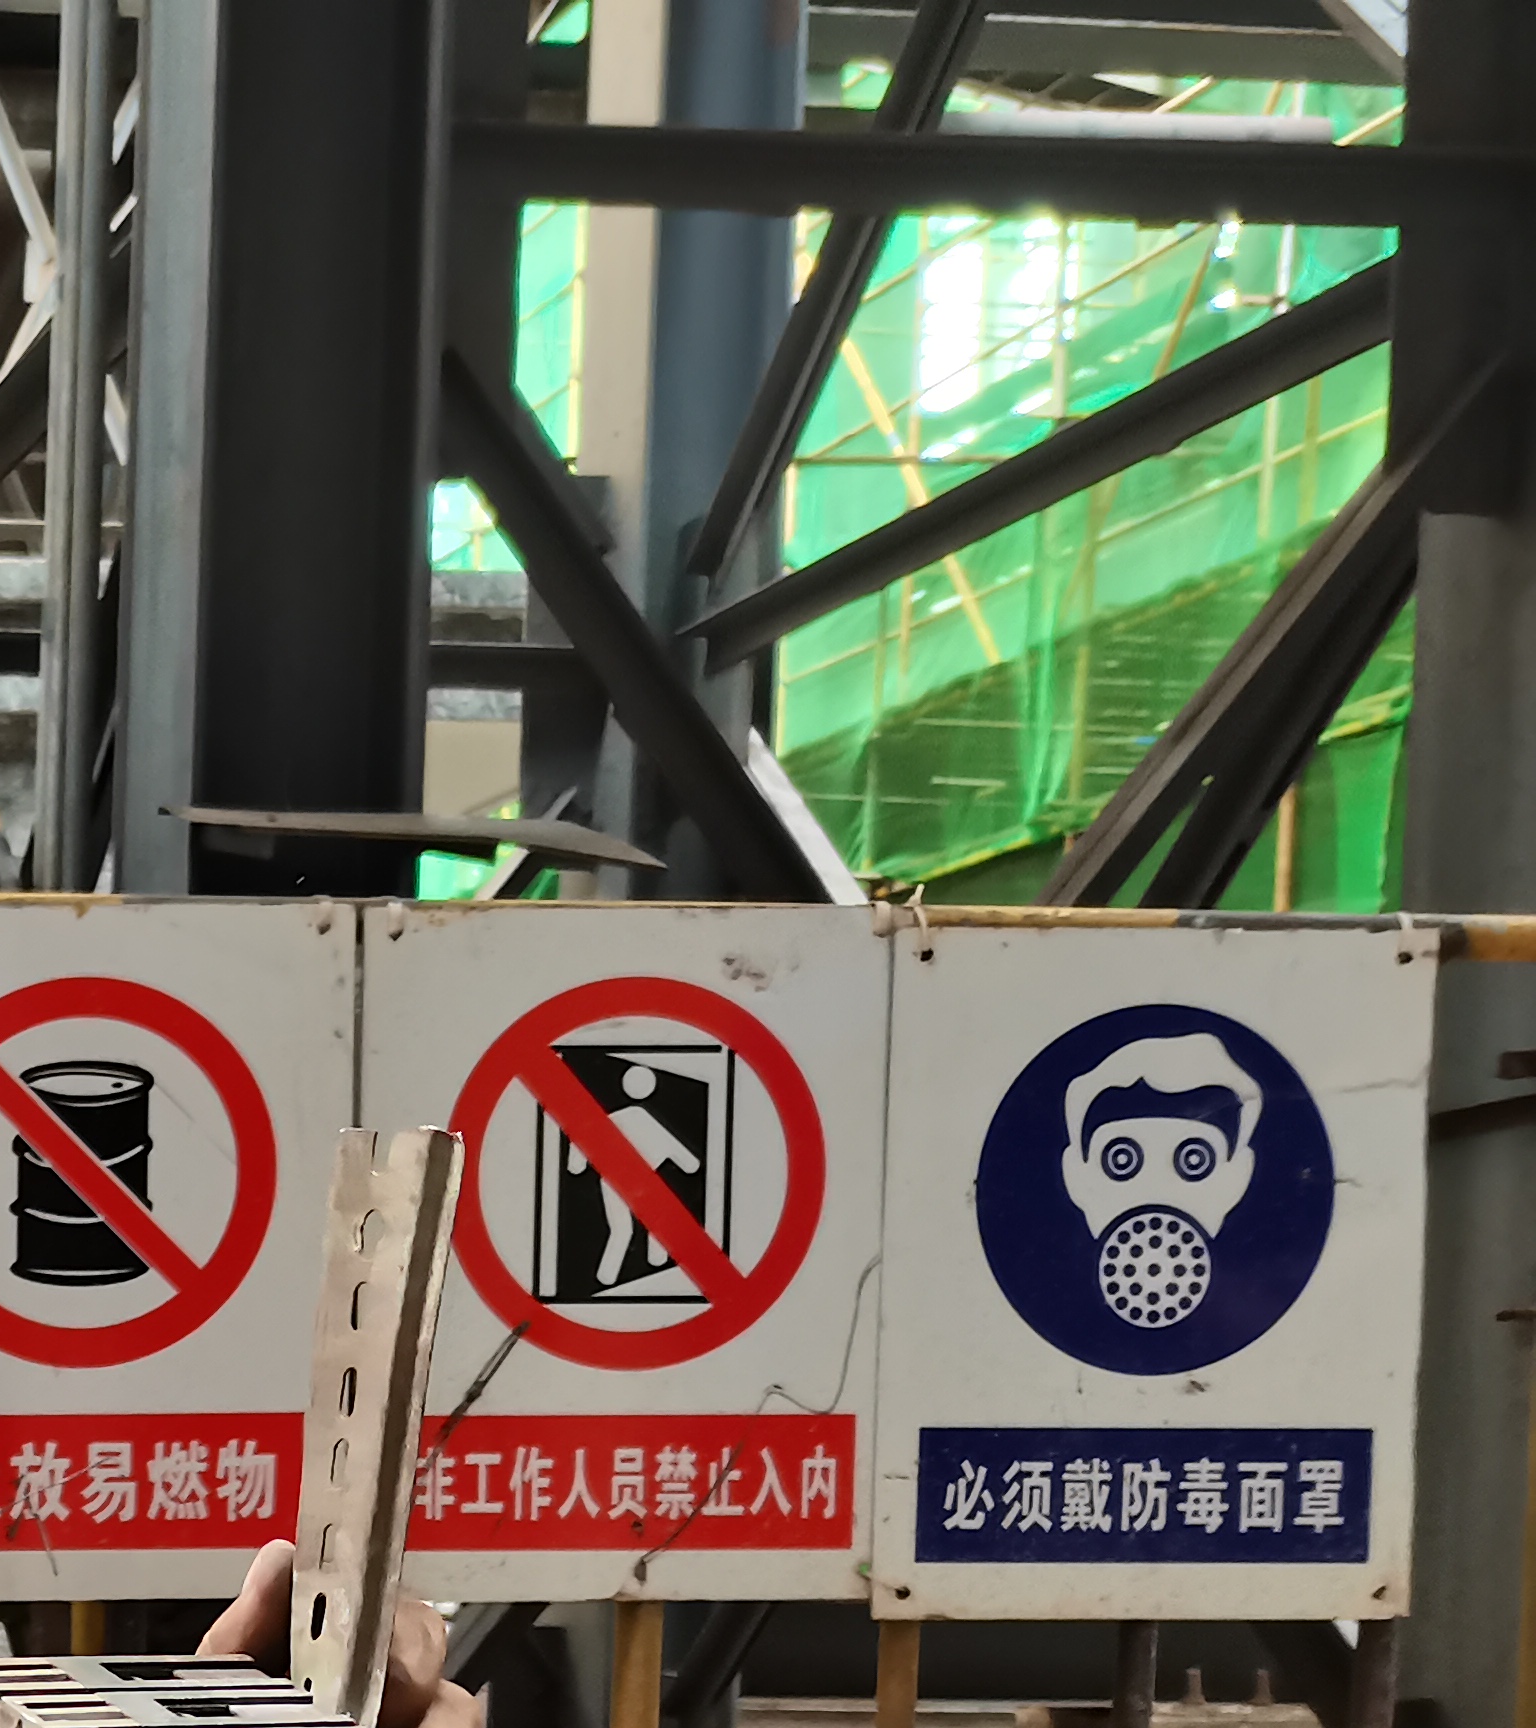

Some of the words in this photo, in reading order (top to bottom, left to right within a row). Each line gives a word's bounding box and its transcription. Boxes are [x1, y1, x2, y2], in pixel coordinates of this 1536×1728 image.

[415, 1444, 838, 1522] 非工作人员禁止入内
[942, 1456, 1346, 1534] 必须戴防毒面罩
